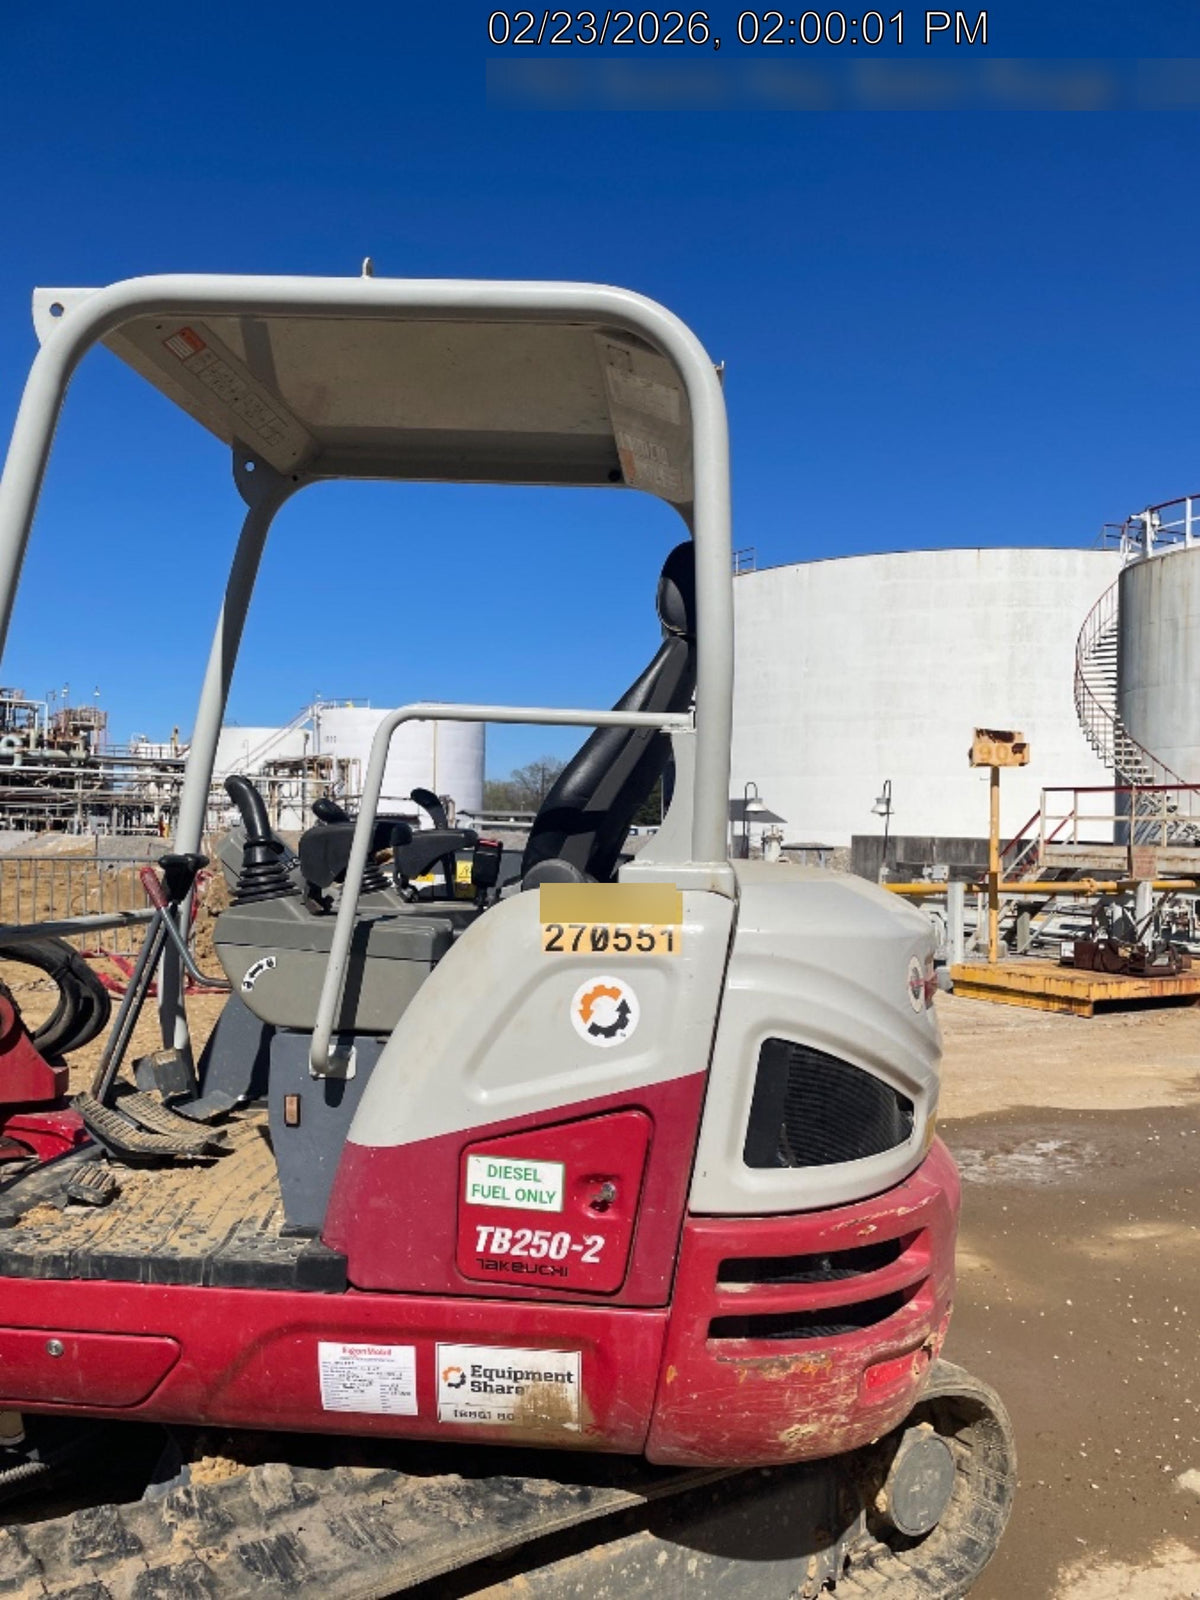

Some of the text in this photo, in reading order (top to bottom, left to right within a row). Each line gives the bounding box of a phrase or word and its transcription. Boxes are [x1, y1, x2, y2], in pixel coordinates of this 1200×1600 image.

[544, 923, 674, 952] 270551
[487, 1163, 543, 1183] DIESEL
[471, 1183, 557, 1205] FUEL ONLY
[475, 1224, 606, 1264] TB250-2
[470, 1364, 575, 1384] Equipment
[470, 1381, 525, 1396] Share
